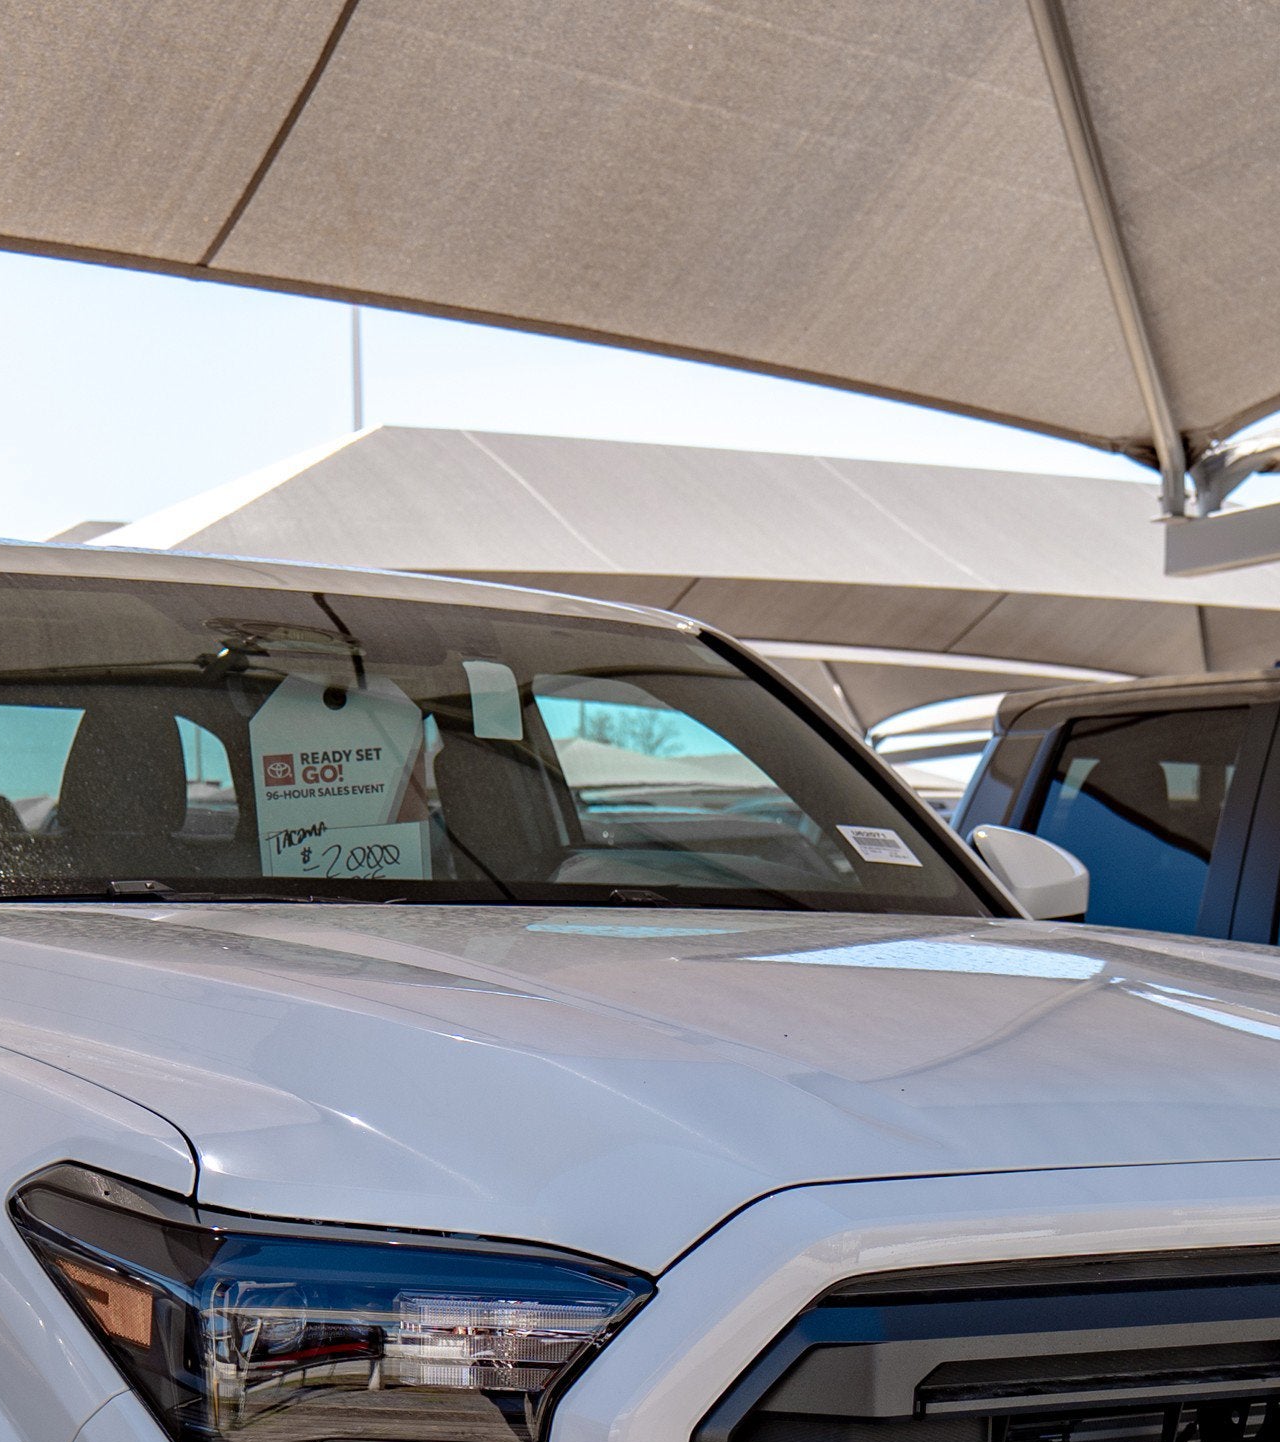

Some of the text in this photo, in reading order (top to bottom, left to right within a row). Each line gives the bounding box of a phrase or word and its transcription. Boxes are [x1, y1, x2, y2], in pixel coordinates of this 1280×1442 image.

[300, 748, 382, 765] READY SET
[301, 764, 344, 784] GO!
[266, 784, 385, 801] 96-HOUR SALES EVENT
